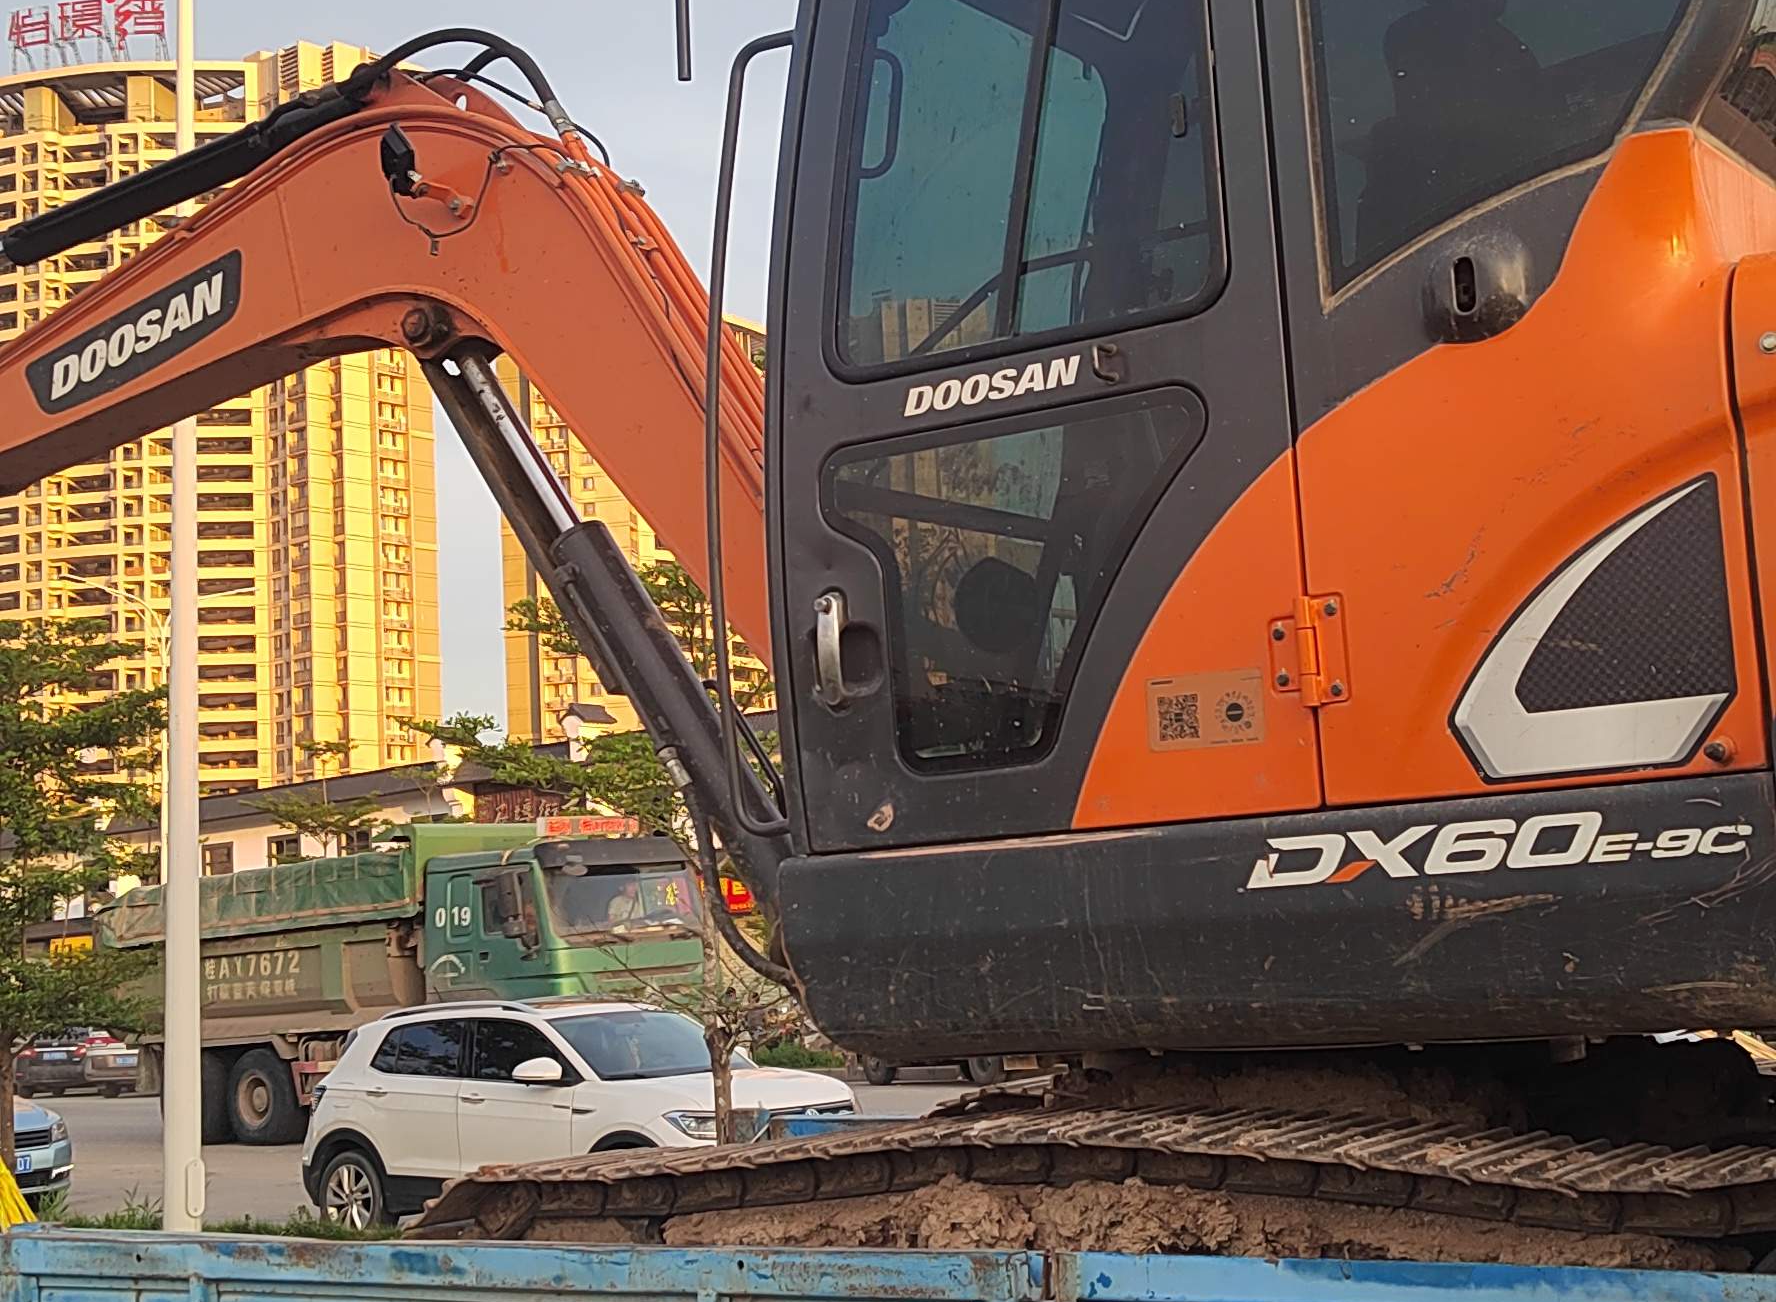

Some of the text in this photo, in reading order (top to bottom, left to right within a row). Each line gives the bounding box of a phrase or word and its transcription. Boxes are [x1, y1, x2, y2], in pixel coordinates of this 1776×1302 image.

[51, 271, 223, 401] DOOSAN
[903, 355, 1081, 417] DOOSAN
[435, 906, 471, 928] 019
